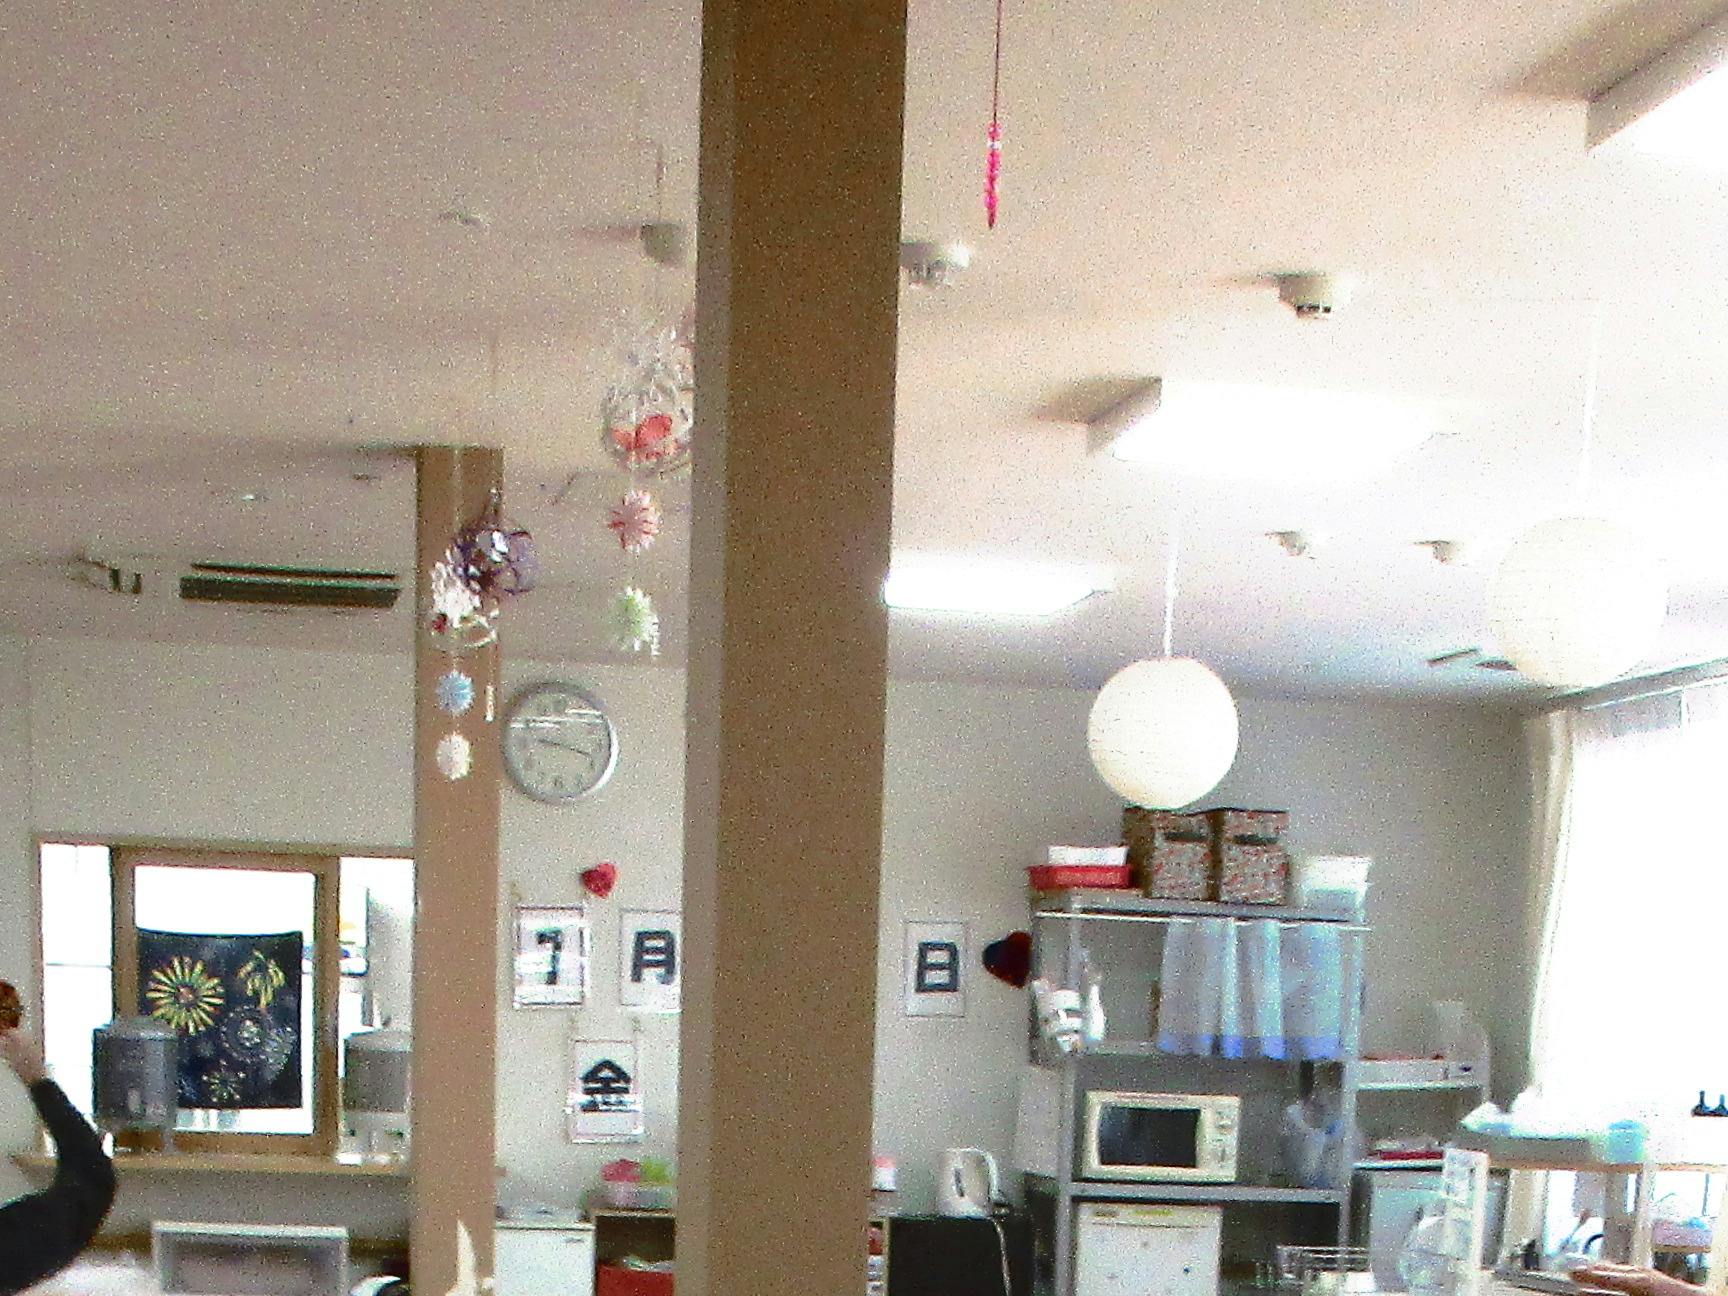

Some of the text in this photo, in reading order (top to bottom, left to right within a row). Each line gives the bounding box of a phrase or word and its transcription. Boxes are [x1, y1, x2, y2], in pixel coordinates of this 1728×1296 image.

[631, 929, 676, 985] 月
[915, 941, 959, 993] 日
[579, 1059, 635, 1113] 金
